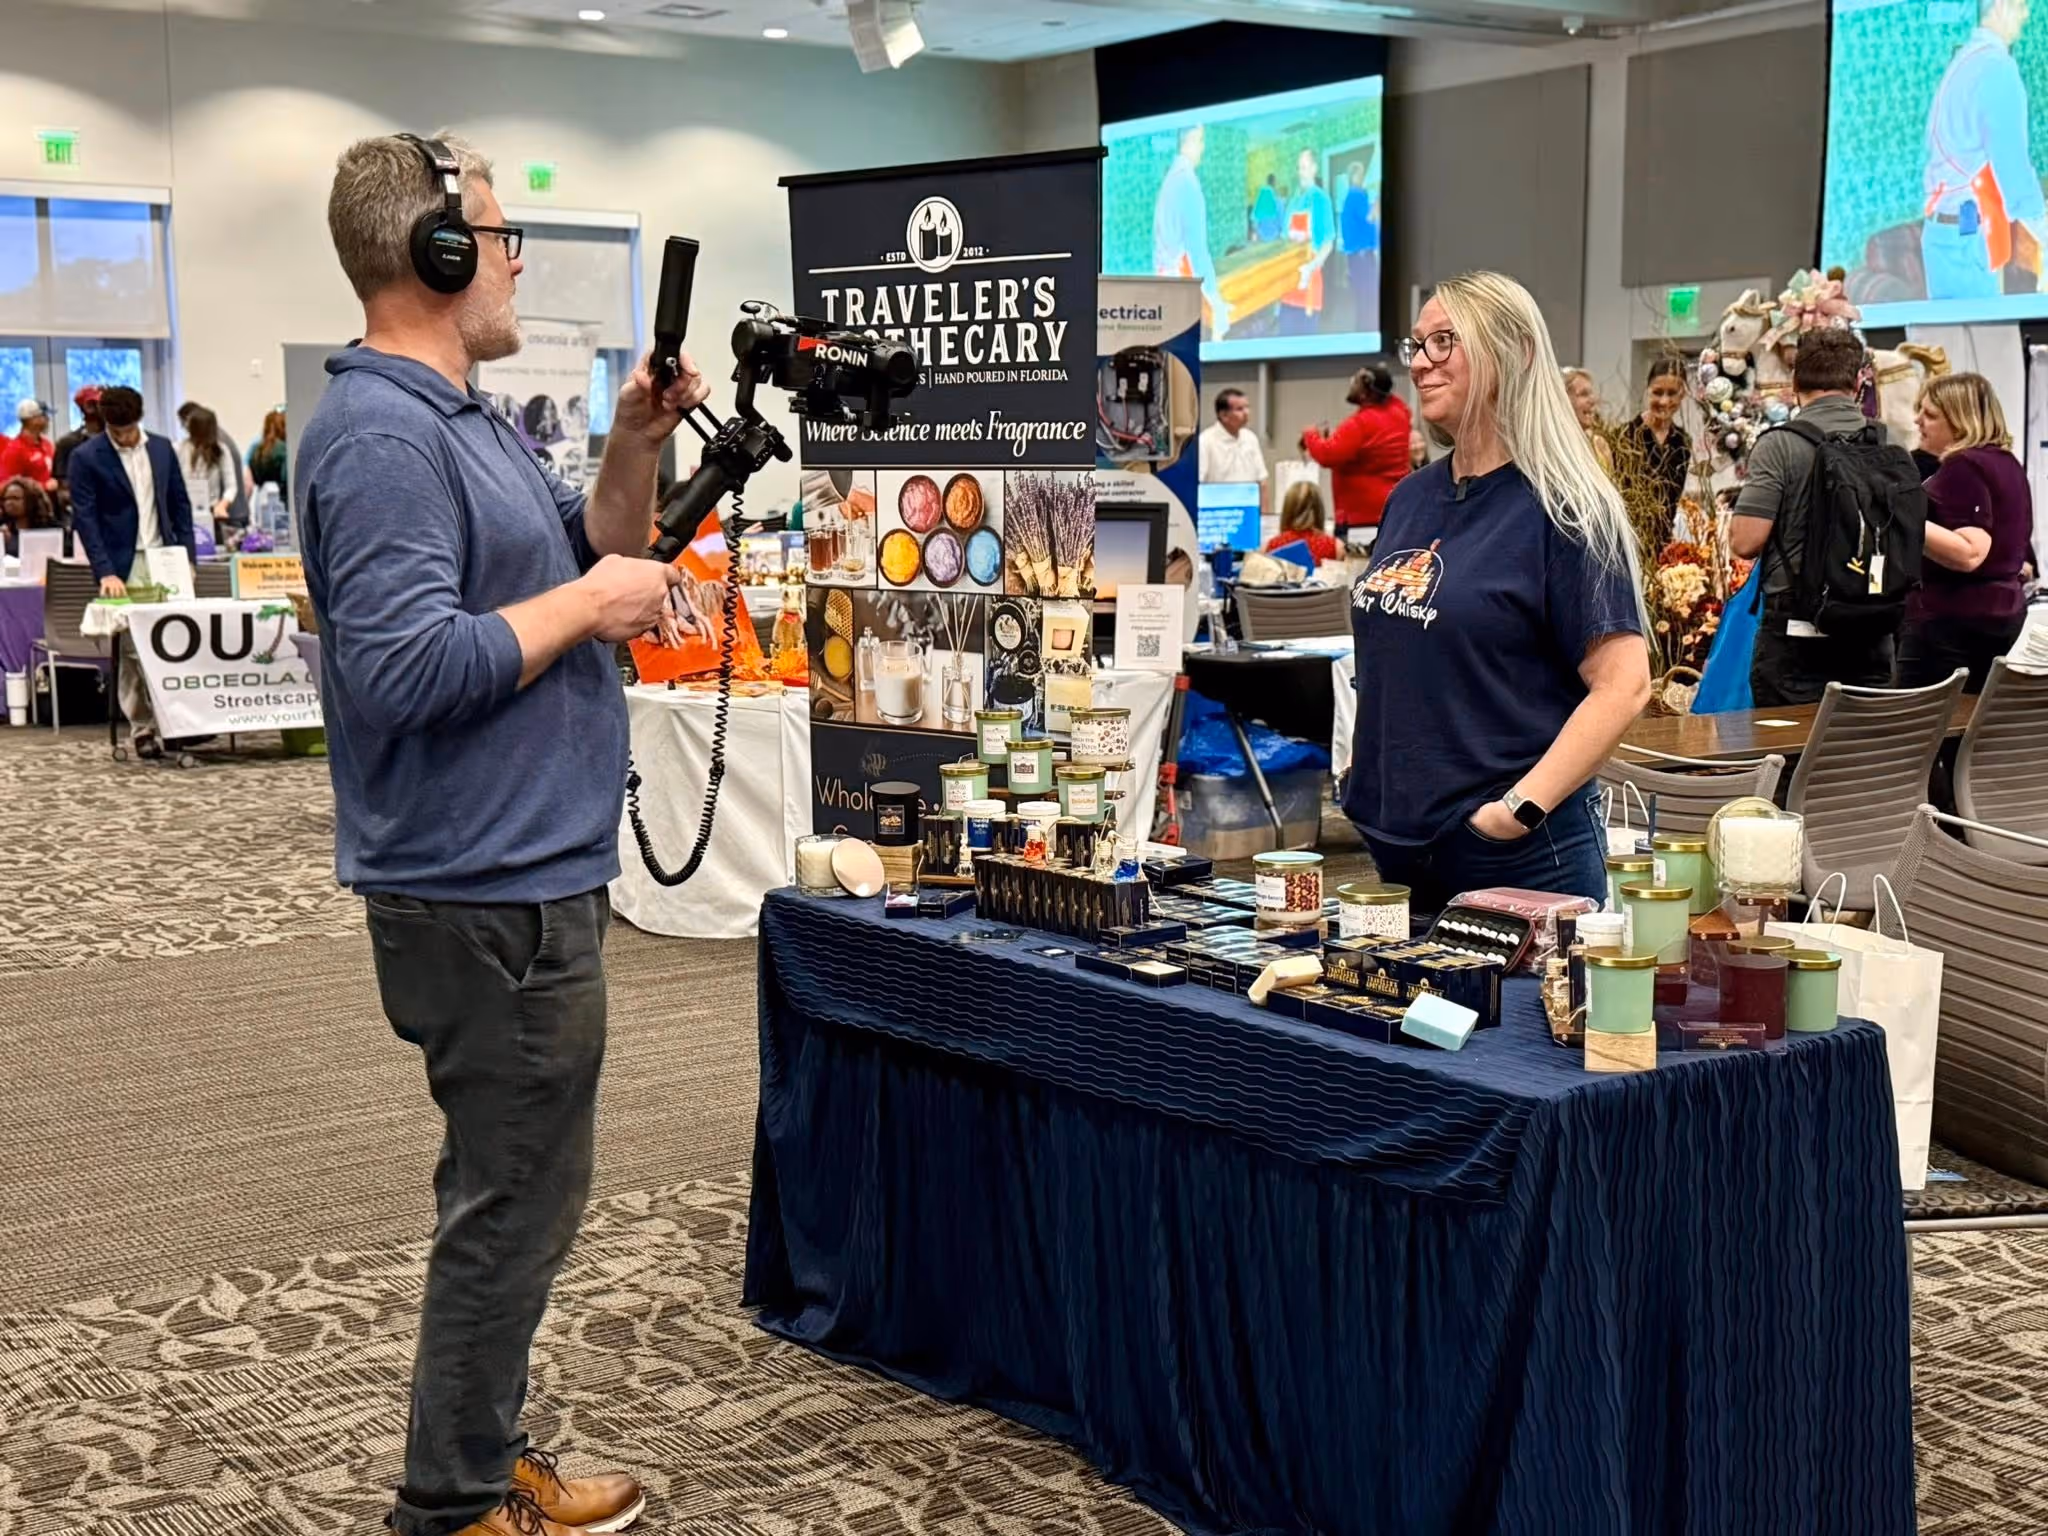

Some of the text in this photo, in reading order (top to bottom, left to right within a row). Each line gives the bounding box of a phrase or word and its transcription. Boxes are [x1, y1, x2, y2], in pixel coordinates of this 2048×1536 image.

[885, 246, 983, 262] ESTD 2012
[821, 276, 1056, 327] TRAVELER'S
[1099, 304, 1162, 320] ectrical
[815, 343, 868, 367] RONIN
[934, 372, 964, 385] HAND
[966, 370, 1005, 383] POURED
[1007, 370, 1018, 382] IN
[1020, 369, 1068, 381] FLORIDA
[806, 420, 858, 442] Where
[935, 418, 983, 440] meets
[985, 410, 1087, 457] Fragrance
[214, 692, 320, 709] Streetscap
